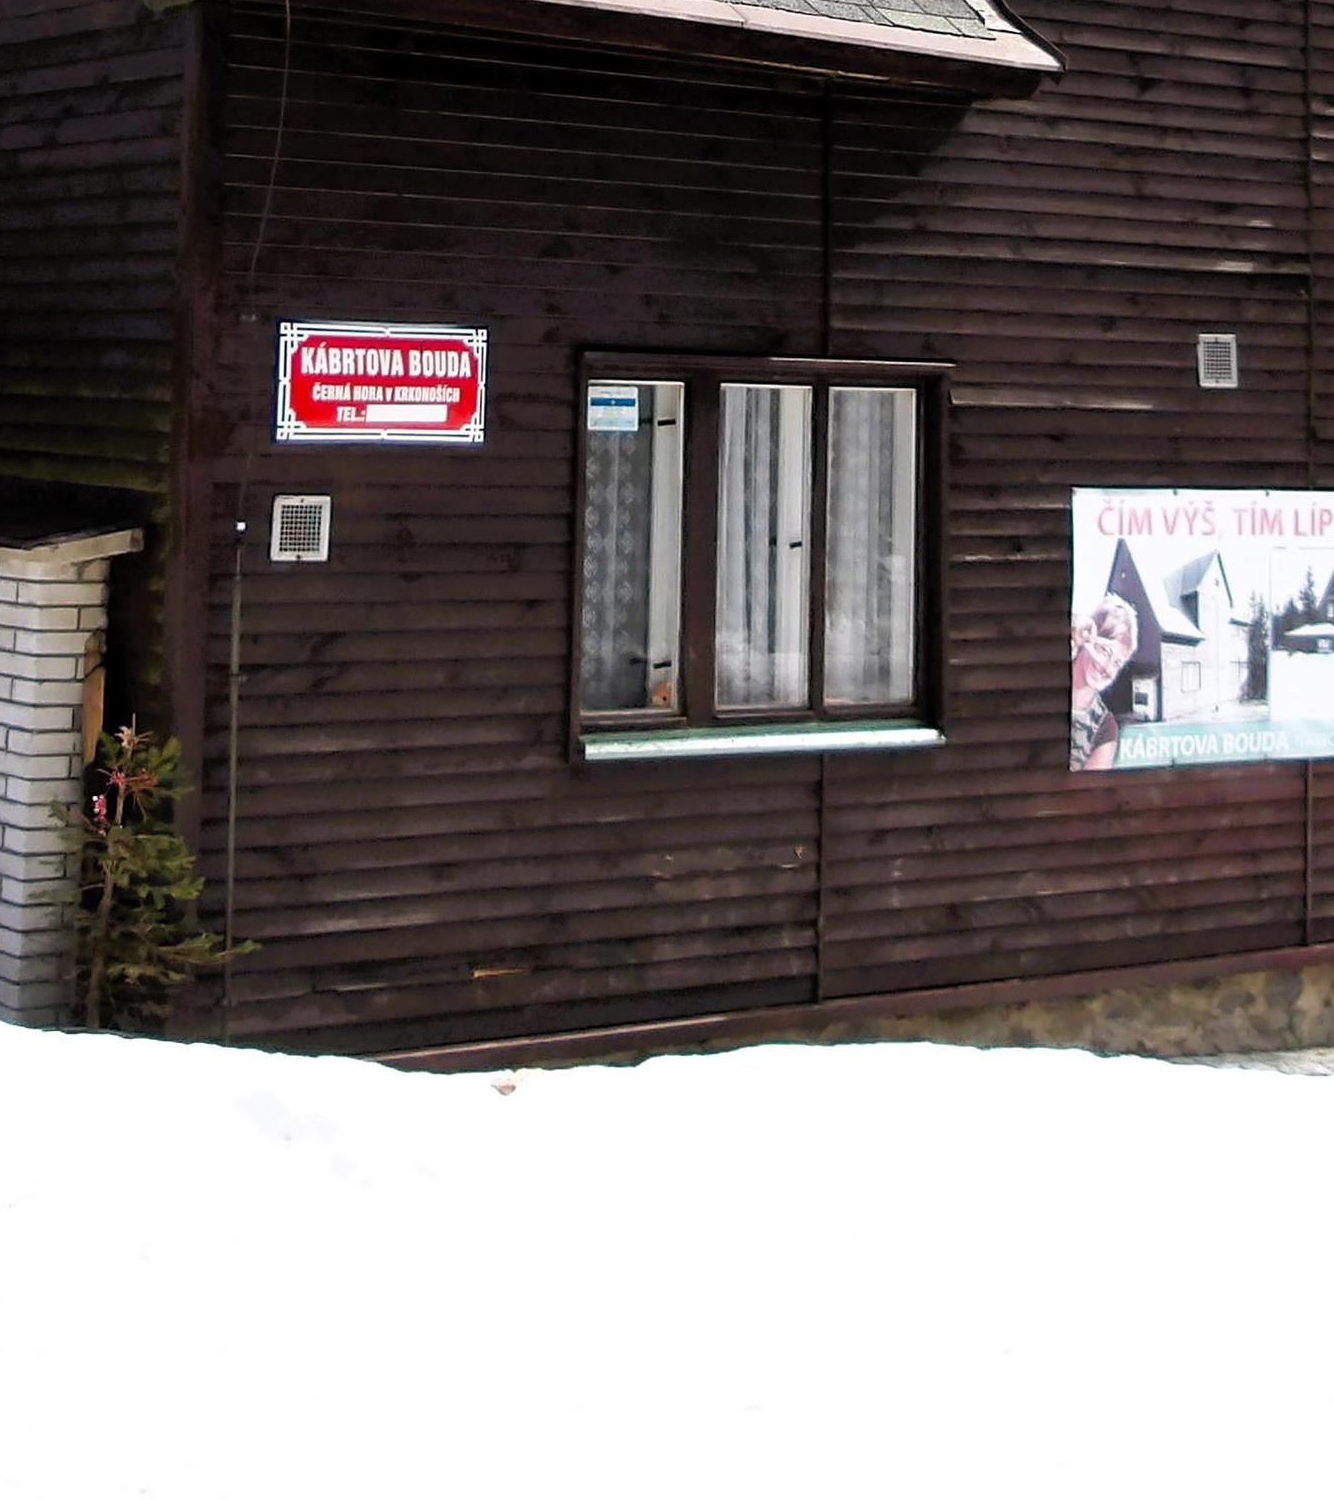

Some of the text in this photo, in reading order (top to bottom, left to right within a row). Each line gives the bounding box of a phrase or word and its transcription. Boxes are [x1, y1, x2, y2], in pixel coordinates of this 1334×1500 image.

[301, 342, 471, 378] KÁBRTOVA BOUDA
[312, 381, 351, 401] ČERNÁ
[353, 385, 384, 402] HORA
[1097, 498, 1152, 536] ČÍM
[1233, 500, 1284, 537] TÍM
[1293, 500, 1334, 537] LÍP
[1120, 733, 1217, 760] KÁBRTOVA
[1223, 730, 1289, 754] BOUDA
